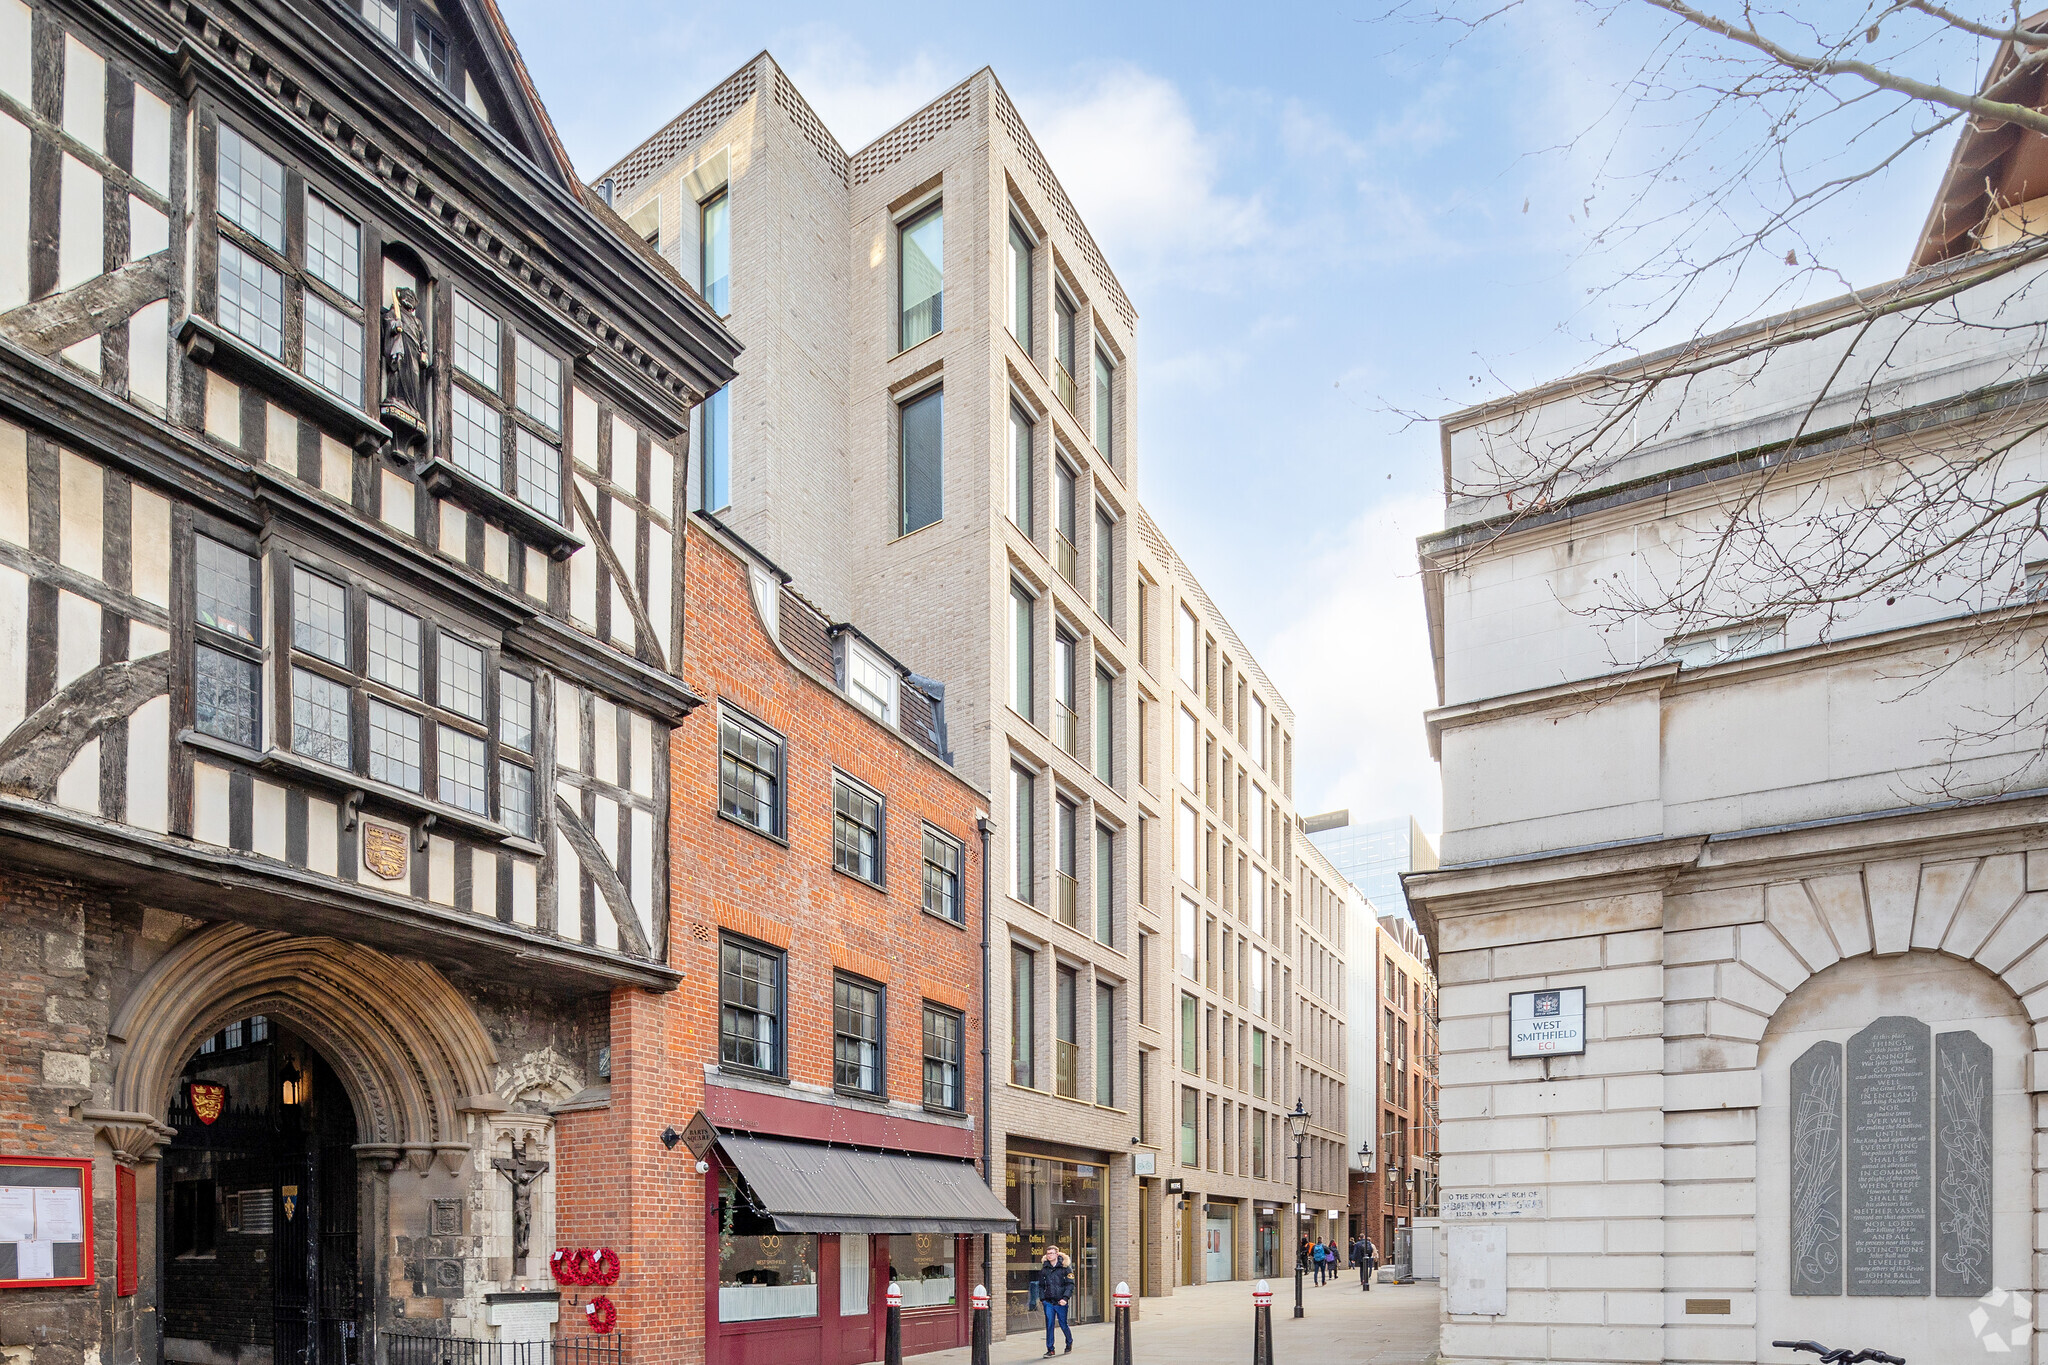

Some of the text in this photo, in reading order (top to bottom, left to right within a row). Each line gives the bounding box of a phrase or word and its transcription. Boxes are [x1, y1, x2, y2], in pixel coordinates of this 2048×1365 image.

[1533, 1020, 1561, 1030] WEST
[1517, 1030, 1577, 1042] SMITHFIELD
[1870, 1052, 1909, 1060] CANNOT
[1860, 1143, 1918, 1151] EVERYTHING
[918, 1234, 930, 1248] 56
